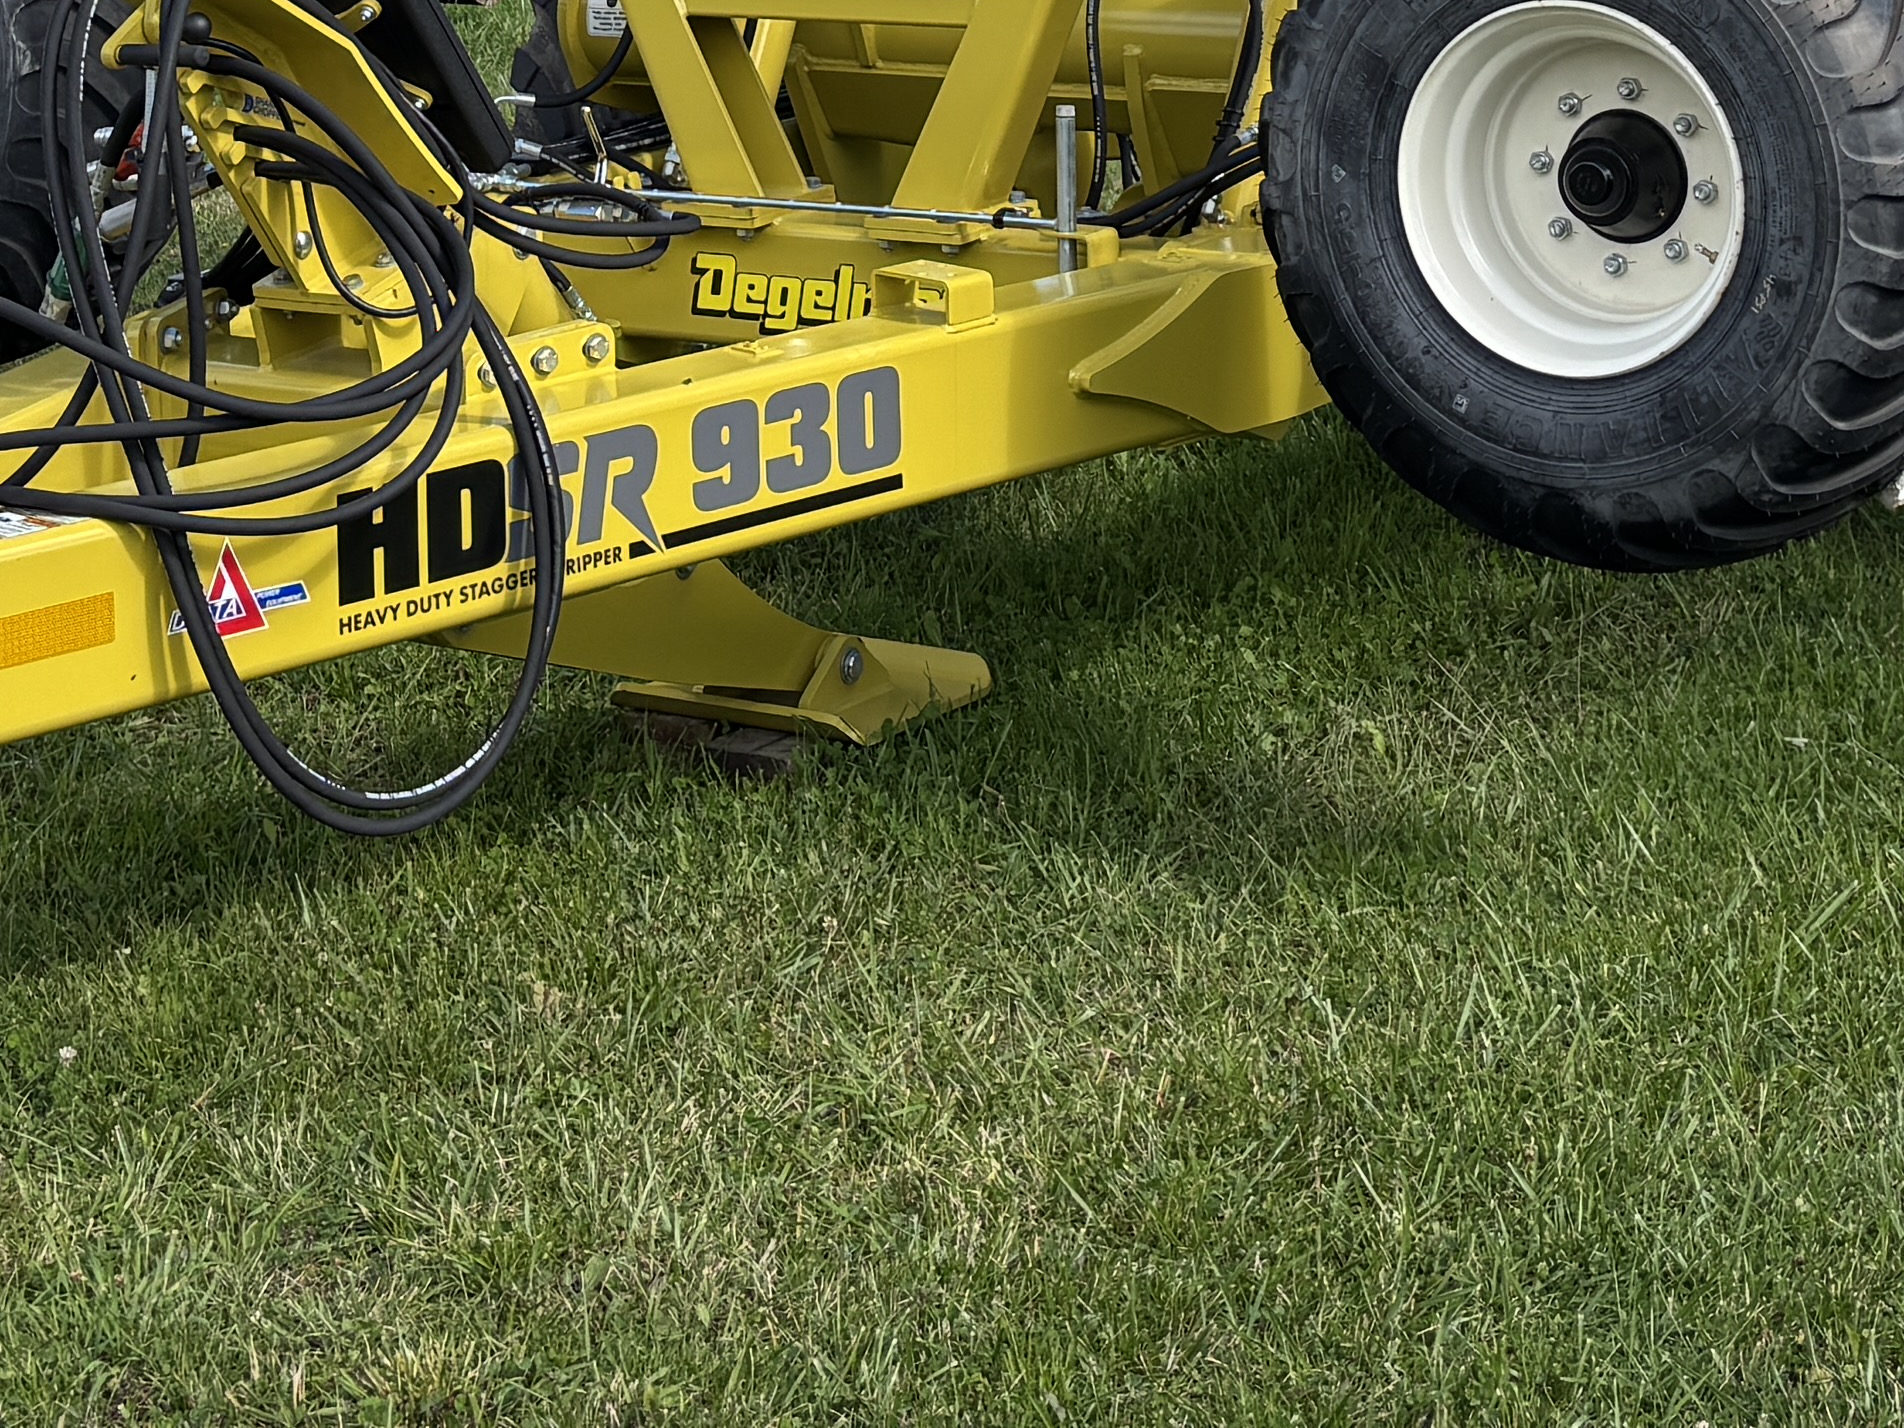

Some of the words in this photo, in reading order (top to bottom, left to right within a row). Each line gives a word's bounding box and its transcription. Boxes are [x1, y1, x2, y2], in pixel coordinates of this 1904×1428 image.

[690, 250, 946, 335] Degel
[335, 423, 666, 607] HDSR
[691, 365, 902, 513] 930
[338, 603, 408, 636] HEAVY
[406, 588, 455, 618] DUTY
[459, 566, 537, 605] STAGGER
[565, 546, 623, 576] RIPPER
